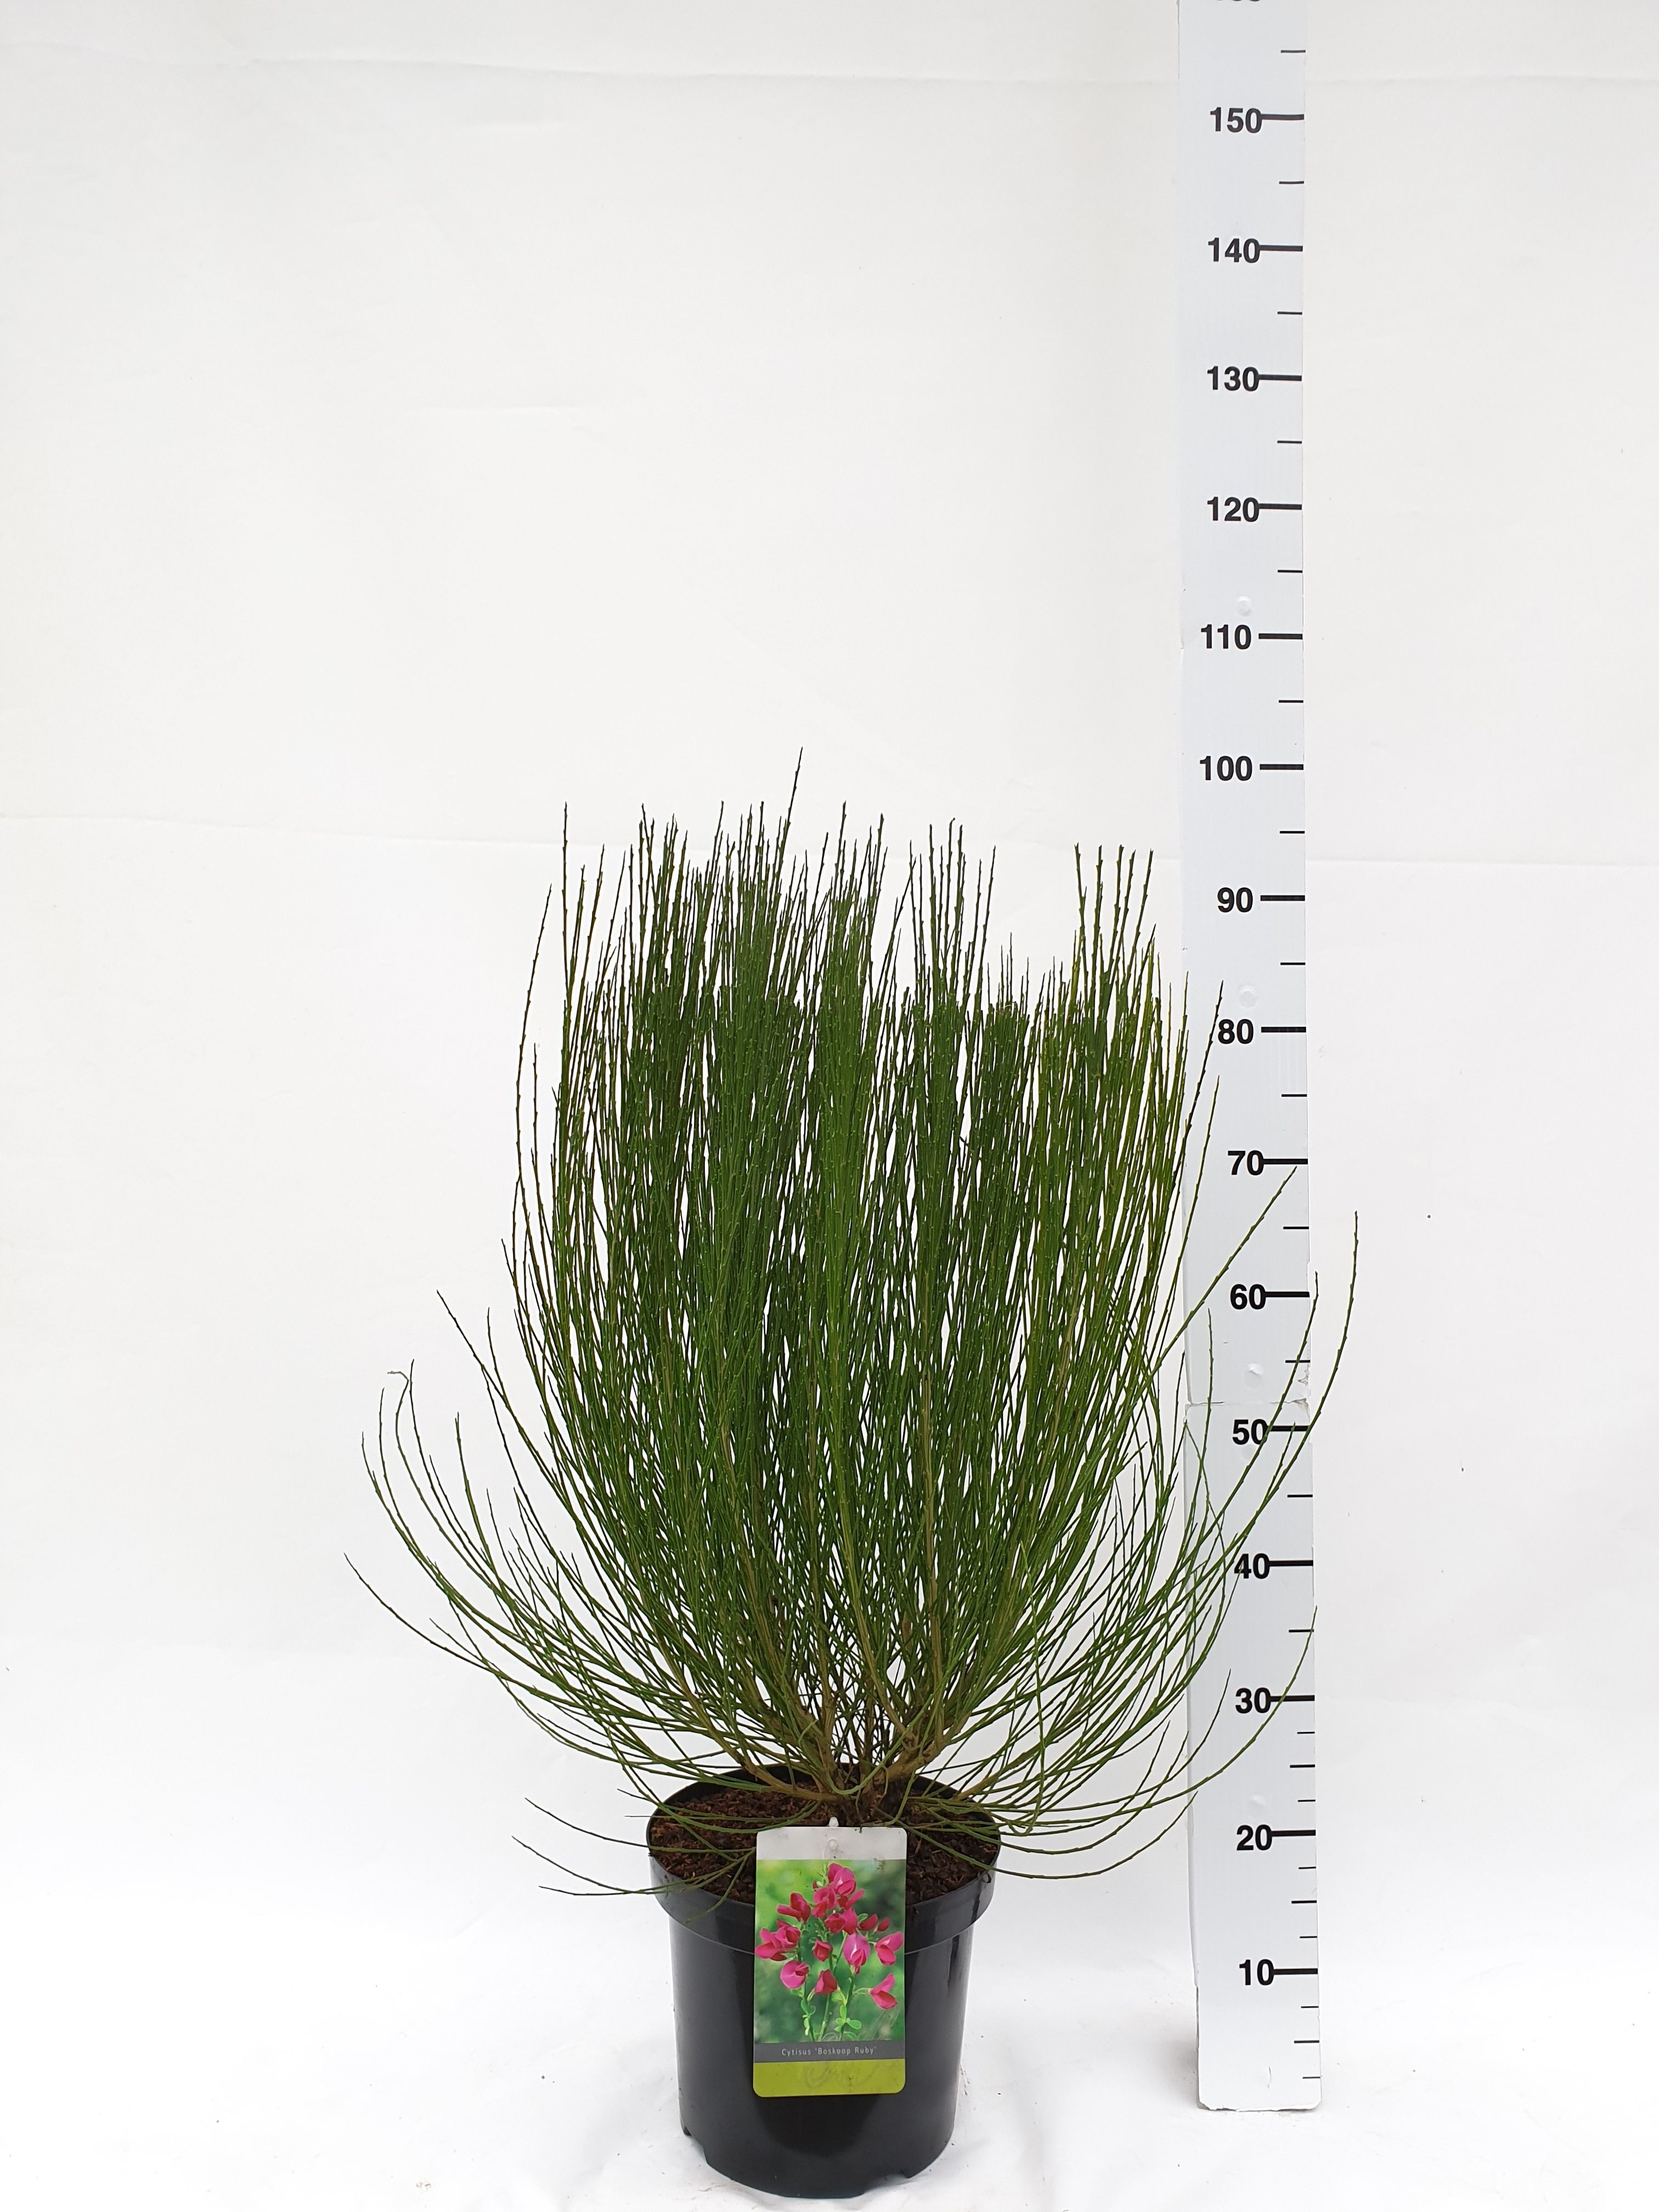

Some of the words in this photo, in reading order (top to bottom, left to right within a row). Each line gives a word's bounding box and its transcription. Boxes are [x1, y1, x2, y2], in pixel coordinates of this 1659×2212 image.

[1210, 108, 1262, 133] 150
[1208, 238, 1261, 263] 140
[1207, 366, 1259, 391] 130
[1207, 496, 1259, 522] 120
[1201, 624, 1251, 649] 110
[1200, 756, 1252, 781] 100
[1217, 888, 1253, 912] 90
[1218, 1019, 1254, 1044] 80
[1228, 1150, 1264, 1176] 70
[1231, 1284, 1266, 1310] 60
[1233, 1419, 1268, 1444] 50
[1234, 1553, 1270, 1579] 40
[1235, 1688, 1272, 1713] 30
[1237, 1825, 1272, 1850] 20
[1239, 1959, 1274, 1985] 10
[782, 2048, 811, 2056] Cytisus
